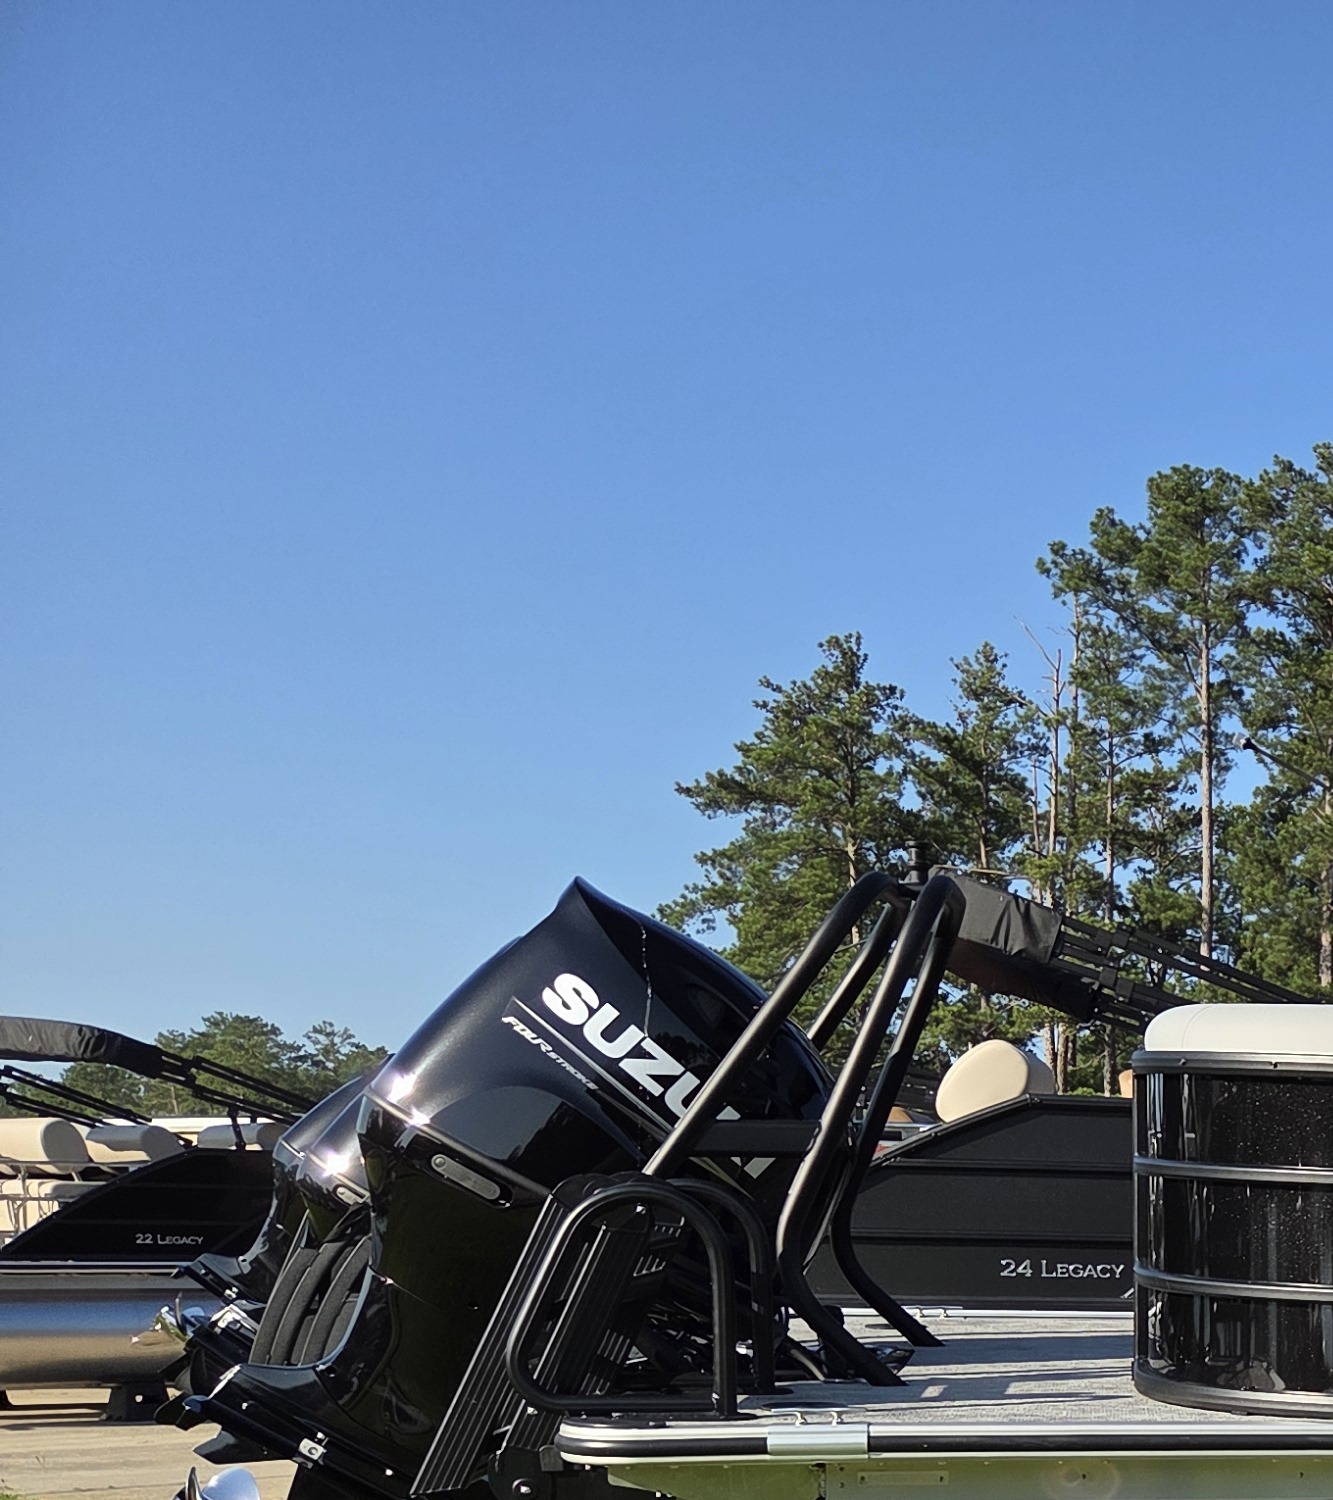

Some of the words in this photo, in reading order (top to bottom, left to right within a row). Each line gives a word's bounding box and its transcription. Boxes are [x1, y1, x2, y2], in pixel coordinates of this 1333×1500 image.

[501, 1015, 553, 1053] FOUR
[135, 1233, 154, 1244] 22
[157, 1233, 204, 1245] LEGACY
[1000, 1259, 1033, 1278] 24
[1040, 1259, 1125, 1279] LEGACY
